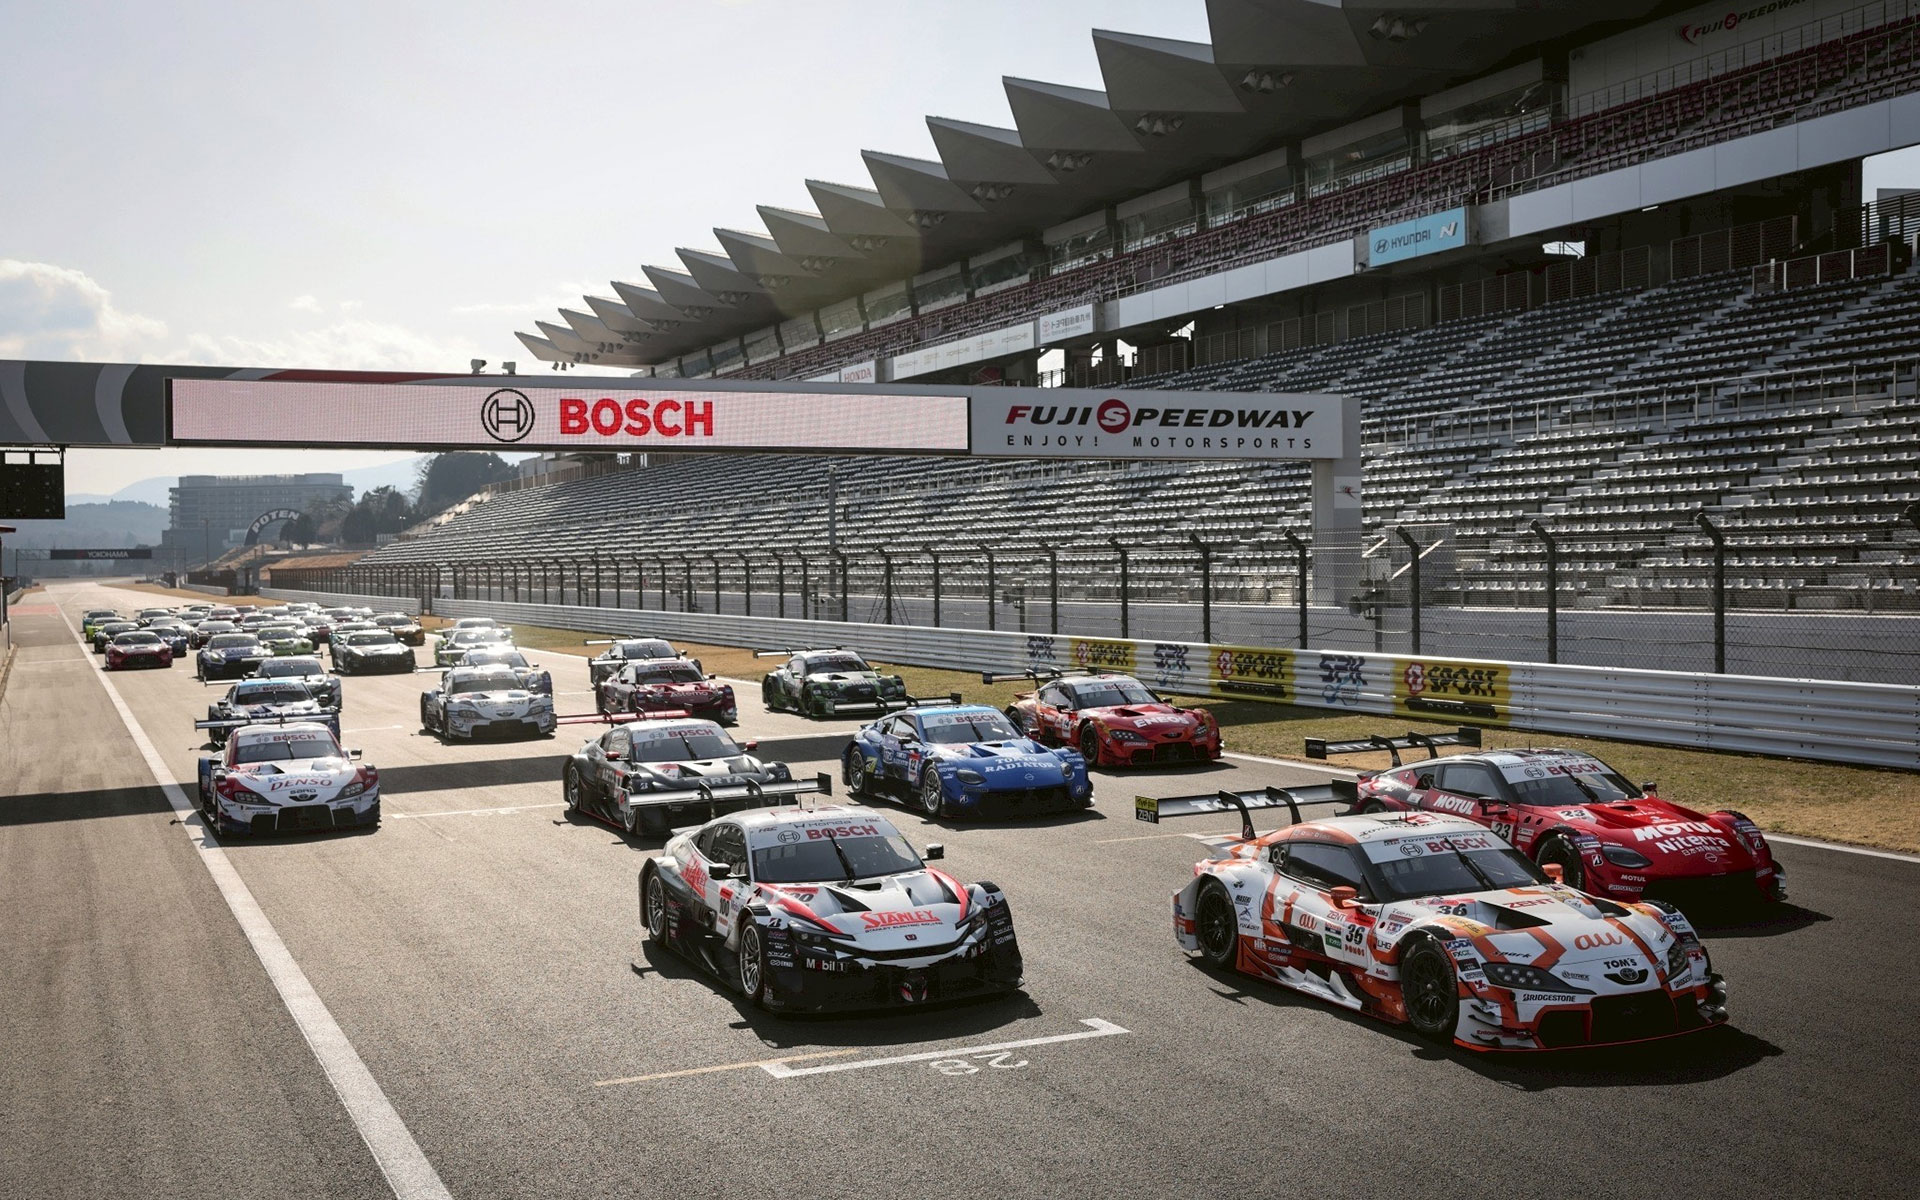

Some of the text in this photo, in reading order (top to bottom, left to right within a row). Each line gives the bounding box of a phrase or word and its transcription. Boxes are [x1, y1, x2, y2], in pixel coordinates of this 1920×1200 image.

[1724, 0, 1806, 29] SPEEDWA
[1391, 229, 1431, 249] HYUNDAI
[844, 367, 872, 383] HONDA
[560, 398, 713, 436] BOSCH
[1005, 405, 1315, 430] FUJI SPEEDWAY
[1007, 435, 1312, 449] ENJOY! MOTORSPORTS
[251, 509, 299, 534] POTEN
[1104, 683, 1136, 691] BOSCH
[670, 690, 709, 698] Astemo
[955, 715, 998, 724] BOSCH
[1132, 716, 1189, 728] ENEOS
[272, 733, 317, 742] BOSCH
[668, 728, 714, 739] BOSCH
[995, 755, 1037, 764] TOKYO
[984, 761, 1056, 773] RADIATOR
[1546, 763, 1602, 776] BOSCH
[270, 779, 333, 792] DENSO
[1433, 794, 1476, 815] MOTUL
[808, 819, 852, 828] Honda
[806, 825, 879, 840] BOSCH
[1493, 823, 1511, 839] 23
[1632, 821, 1723, 842] MOTUL
[1425, 837, 1493, 853] BOSCH
[1655, 834, 1731, 854] Niterra
[1621, 874, 1647, 882] MOTUL
[1437, 903, 1468, 916] 36
[1502, 898, 1556, 909] ZENT
[859, 910, 944, 930] STANLEY
[1326, 909, 1346, 922] ZENT
[1345, 923, 1365, 945] 36
[1574, 932, 1623, 950] au
[806, 957, 836, 972] Mobil
[1604, 957, 1638, 970] TOM'S
[1522, 993, 1576, 1003] BRIDGESTONE
